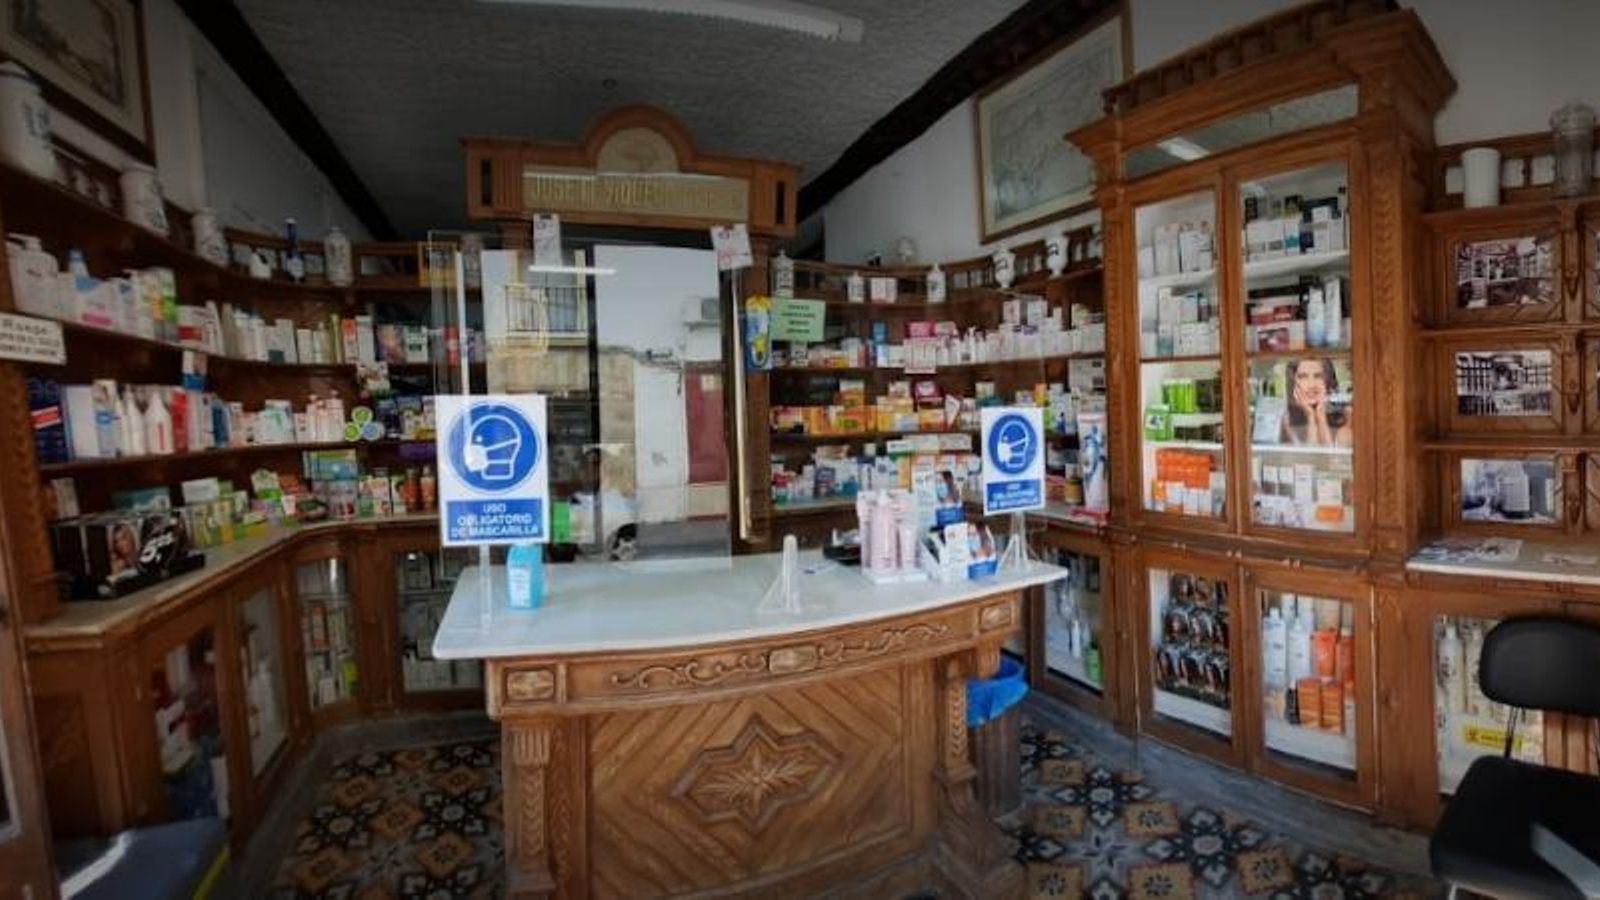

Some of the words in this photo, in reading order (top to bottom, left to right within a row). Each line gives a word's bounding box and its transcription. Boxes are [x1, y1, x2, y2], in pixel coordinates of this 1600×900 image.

[483, 503, 507, 513] USO
[457, 513, 532, 526] OBLIGATORIO
[451, 527, 467, 538] DE
[469, 525, 539, 537] MASCARILLA
